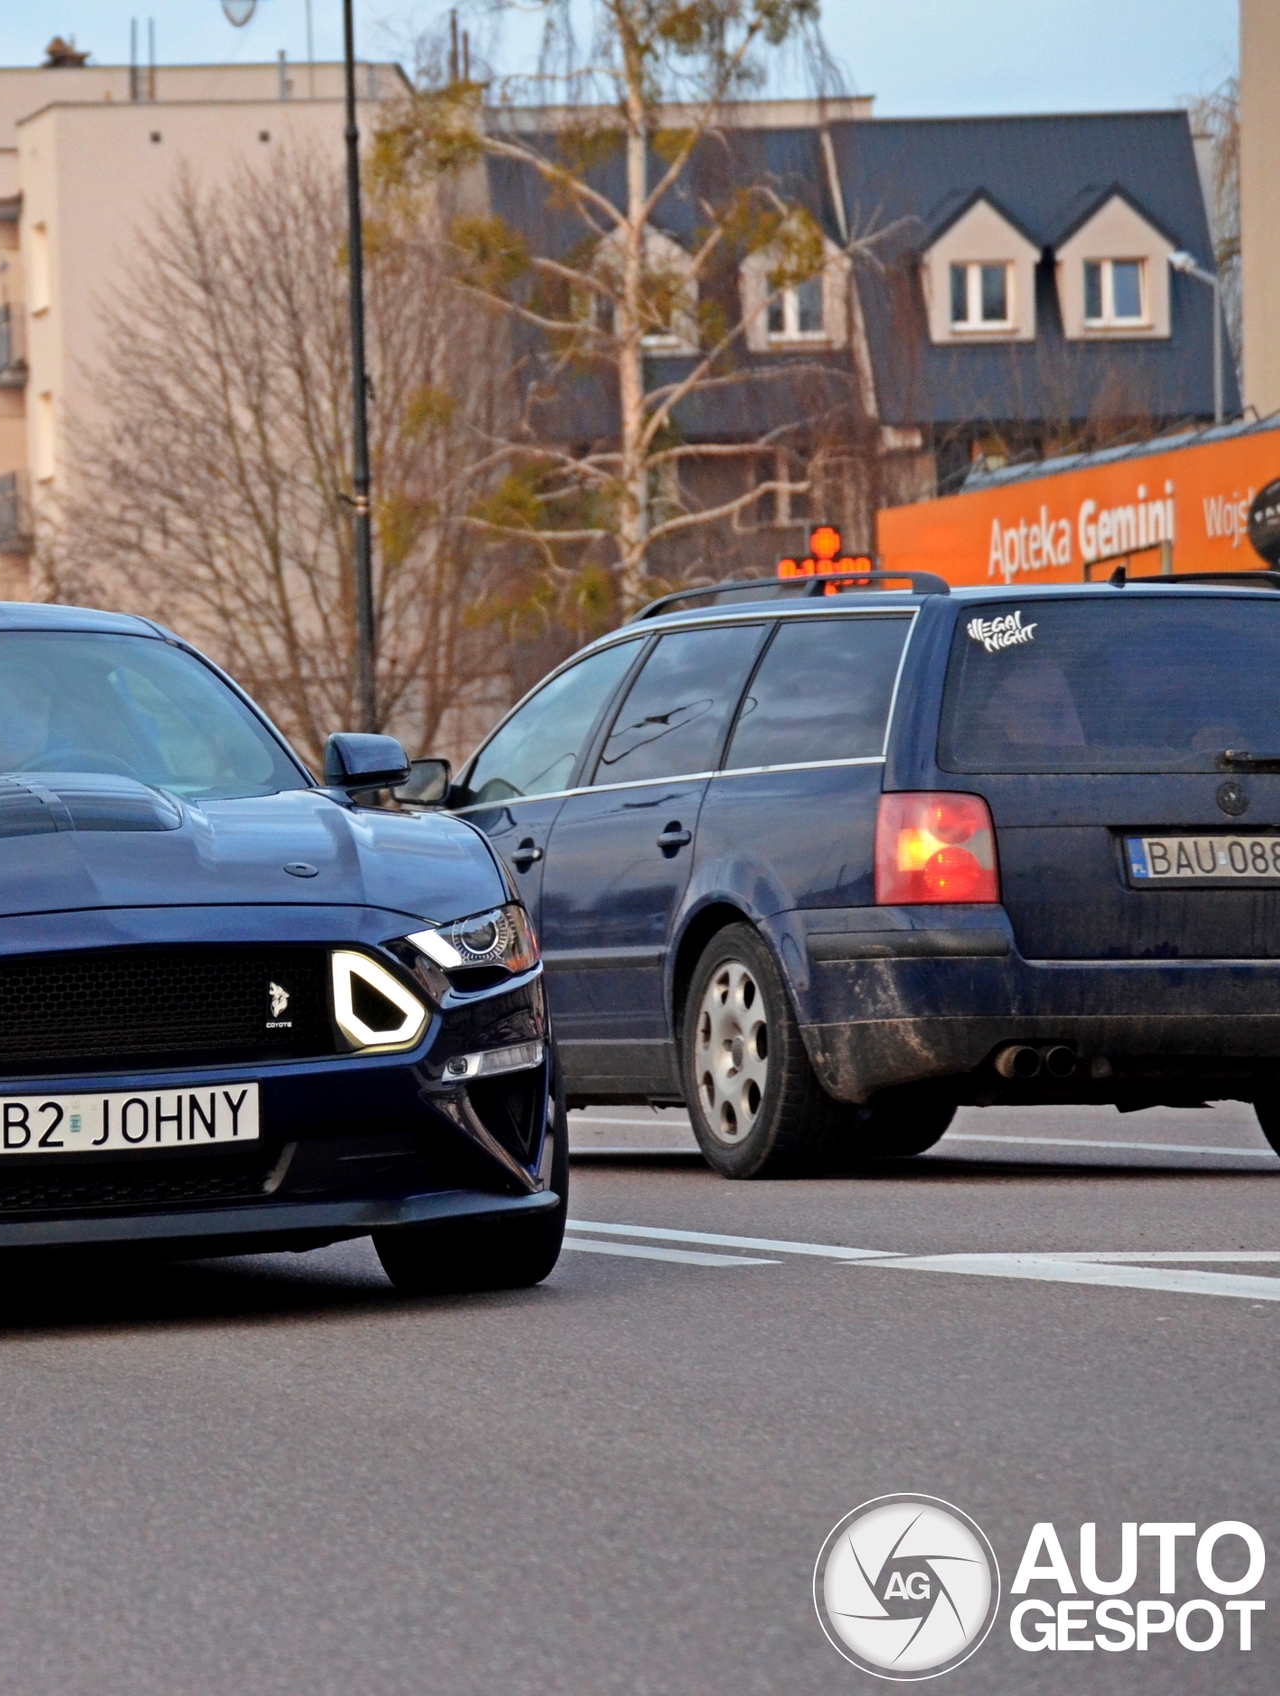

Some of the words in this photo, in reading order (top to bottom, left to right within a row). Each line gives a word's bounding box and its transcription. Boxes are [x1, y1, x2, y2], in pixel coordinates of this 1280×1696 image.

[988, 504, 1072, 585] Apteka
[1078, 479, 1175, 562] Gemini
[1203, 487, 1255, 549] Wojs
[1132, 863, 1147, 874] PL
[1148, 840, 1218, 876] BAU
[266, 1021, 293, 1029] COYOTE
[2, 1101, 65, 1149] B2
[91, 1088, 248, 1146] JOHNY
